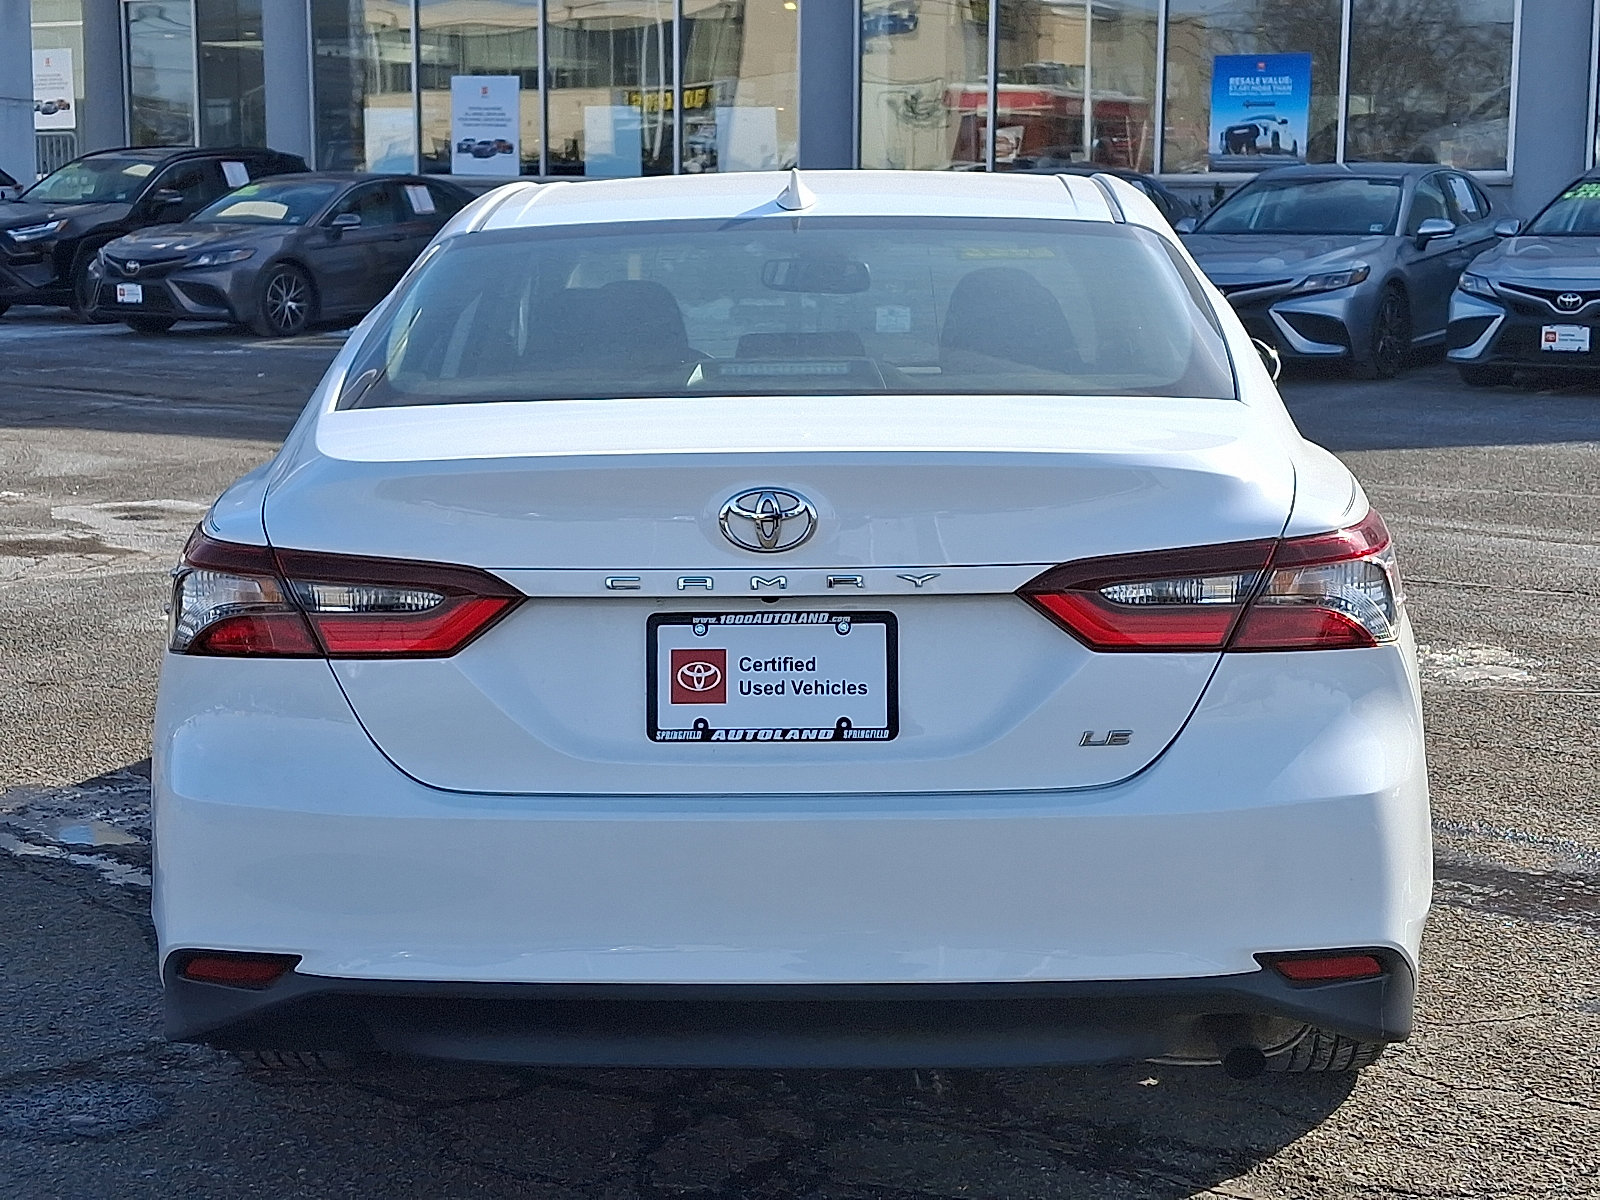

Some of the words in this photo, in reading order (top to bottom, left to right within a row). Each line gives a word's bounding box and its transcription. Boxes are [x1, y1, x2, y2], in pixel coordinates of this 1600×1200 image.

[1229, 76, 1260, 85] RESALE
[605, 573, 941, 590] CAMRY
[739, 656, 816, 672] Certified
[739, 680, 785, 695] Used
[791, 679, 868, 695] Vehicles
[656, 730, 702, 741] SPRINGFIELD
[711, 729, 834, 741] AUTOLAND
[843, 729, 890, 740] SPRINGFIELD
[1079, 729, 1134, 747] LE
